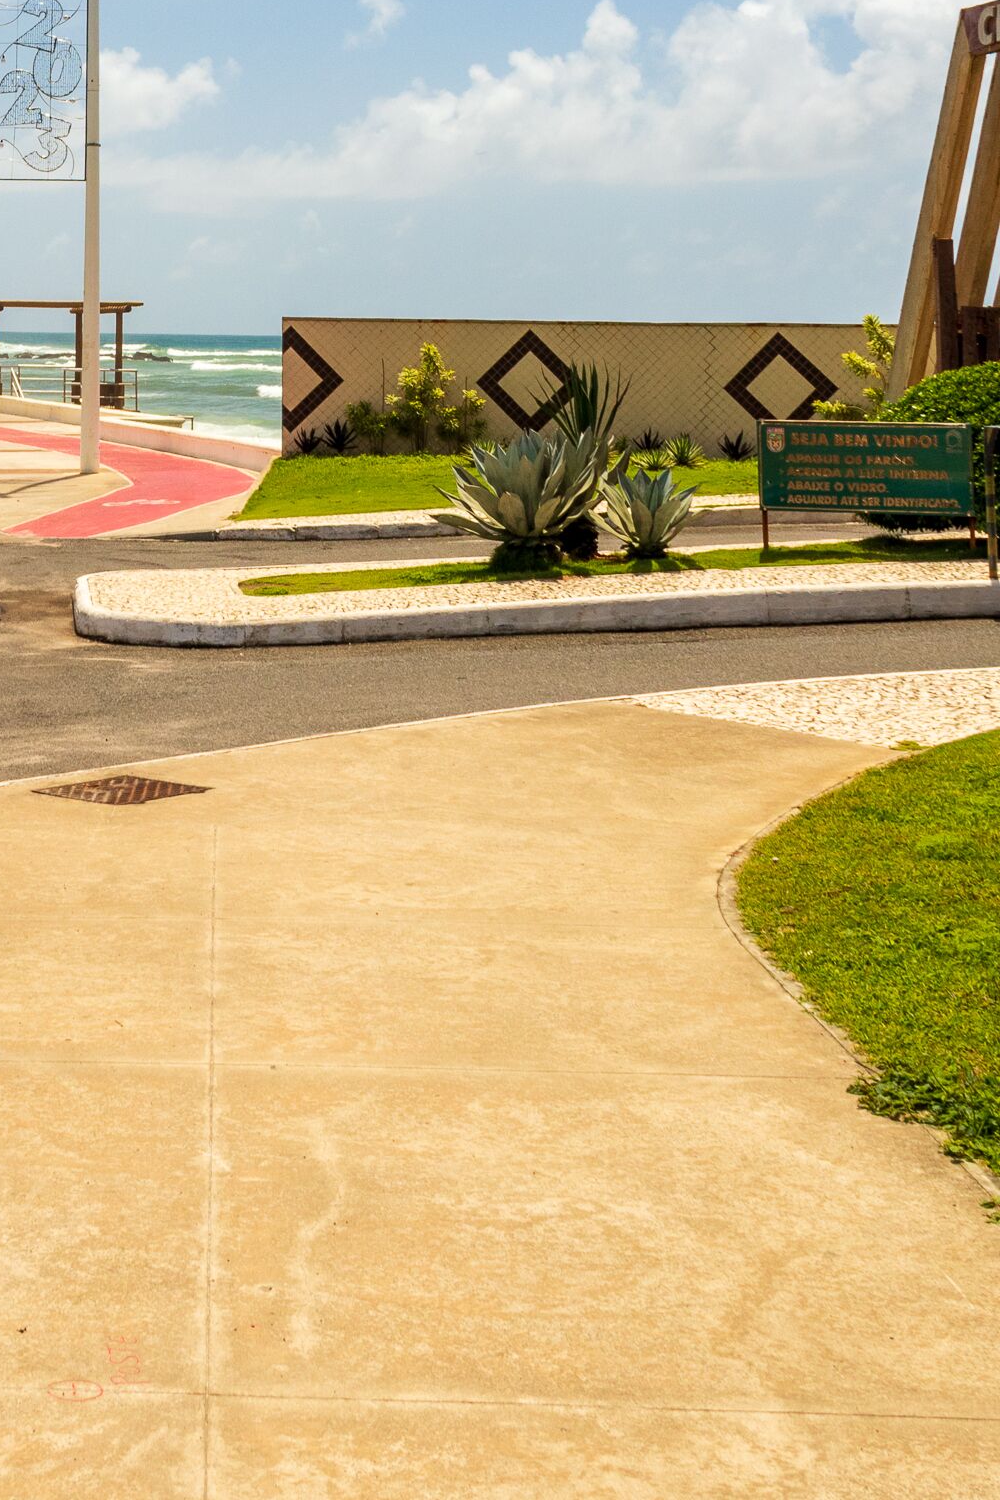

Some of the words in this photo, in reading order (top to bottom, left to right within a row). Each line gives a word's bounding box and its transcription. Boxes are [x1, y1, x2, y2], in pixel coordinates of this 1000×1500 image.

[790, 432, 829, 446] SEJA
[834, 434, 869, 447] BEM
[872, 434, 938, 449] VINDO!
[846, 467, 854, 478] A
[787, 480, 830, 491] ABAIXE
[834, 482, 844, 492] O
[787, 494, 838, 505] AGUARDE
[862, 497, 880, 507] SER
